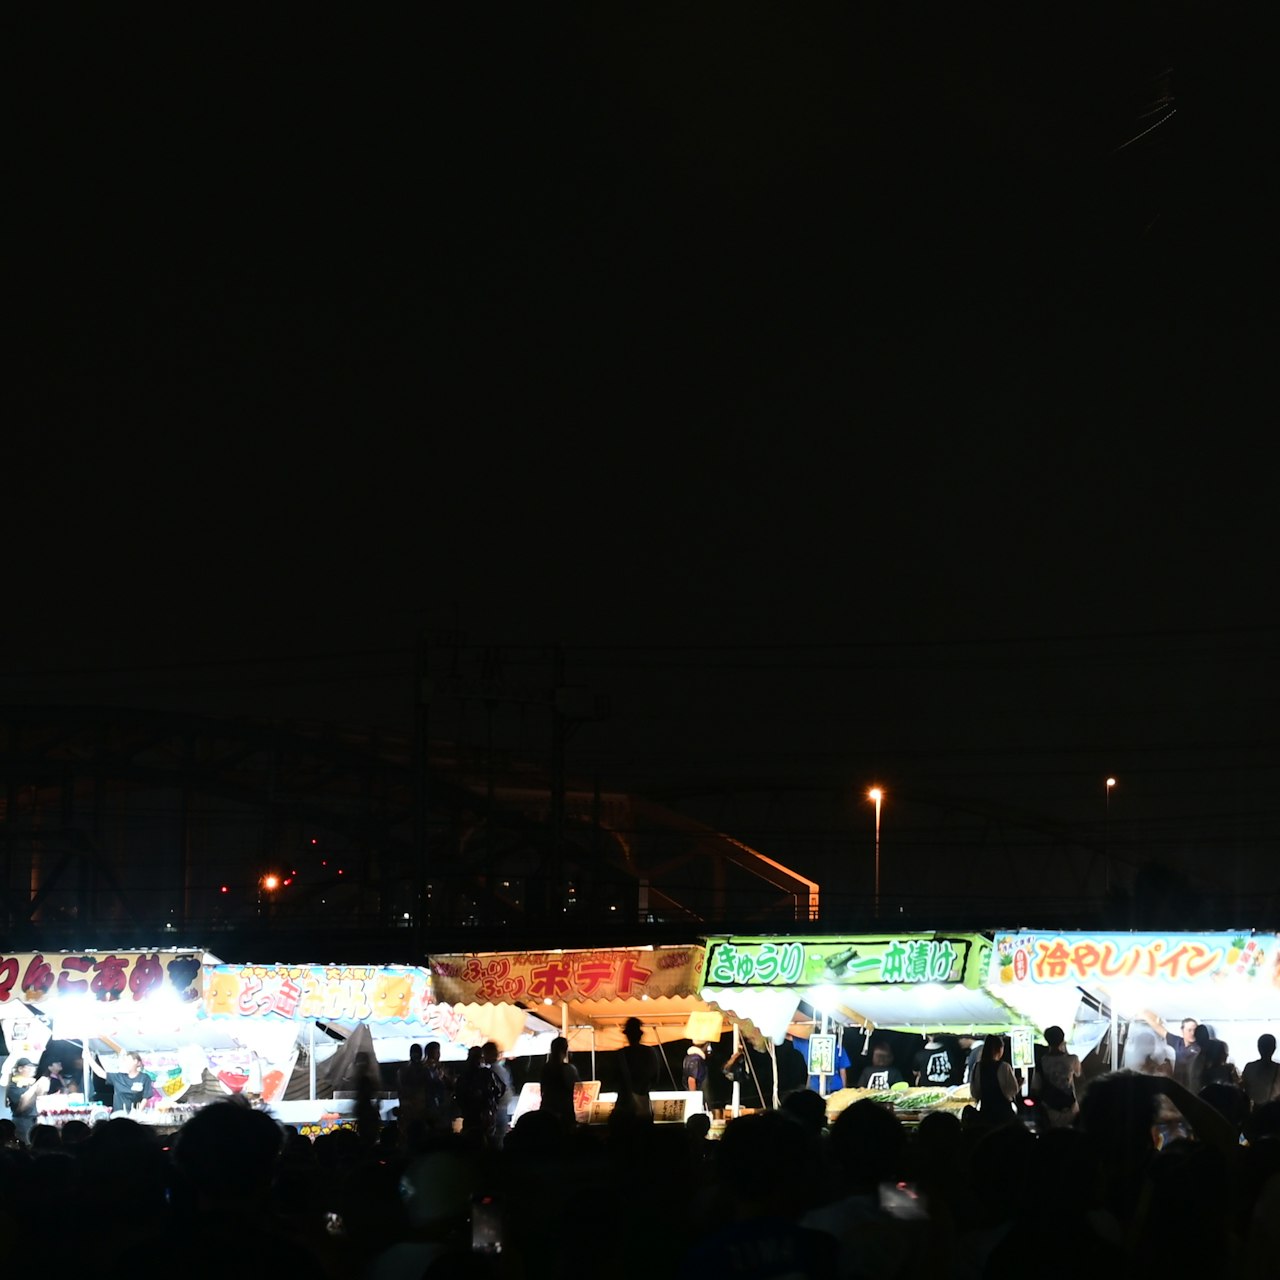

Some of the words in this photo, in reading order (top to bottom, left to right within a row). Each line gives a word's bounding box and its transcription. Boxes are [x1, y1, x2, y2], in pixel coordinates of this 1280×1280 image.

[527, 958, 653, 1001] ポテト
[712, 942, 806, 984] きゅうり
[849, 939, 957, 983] 一本漬け
[1034, 941, 1220, 978] 冷やしパイン
